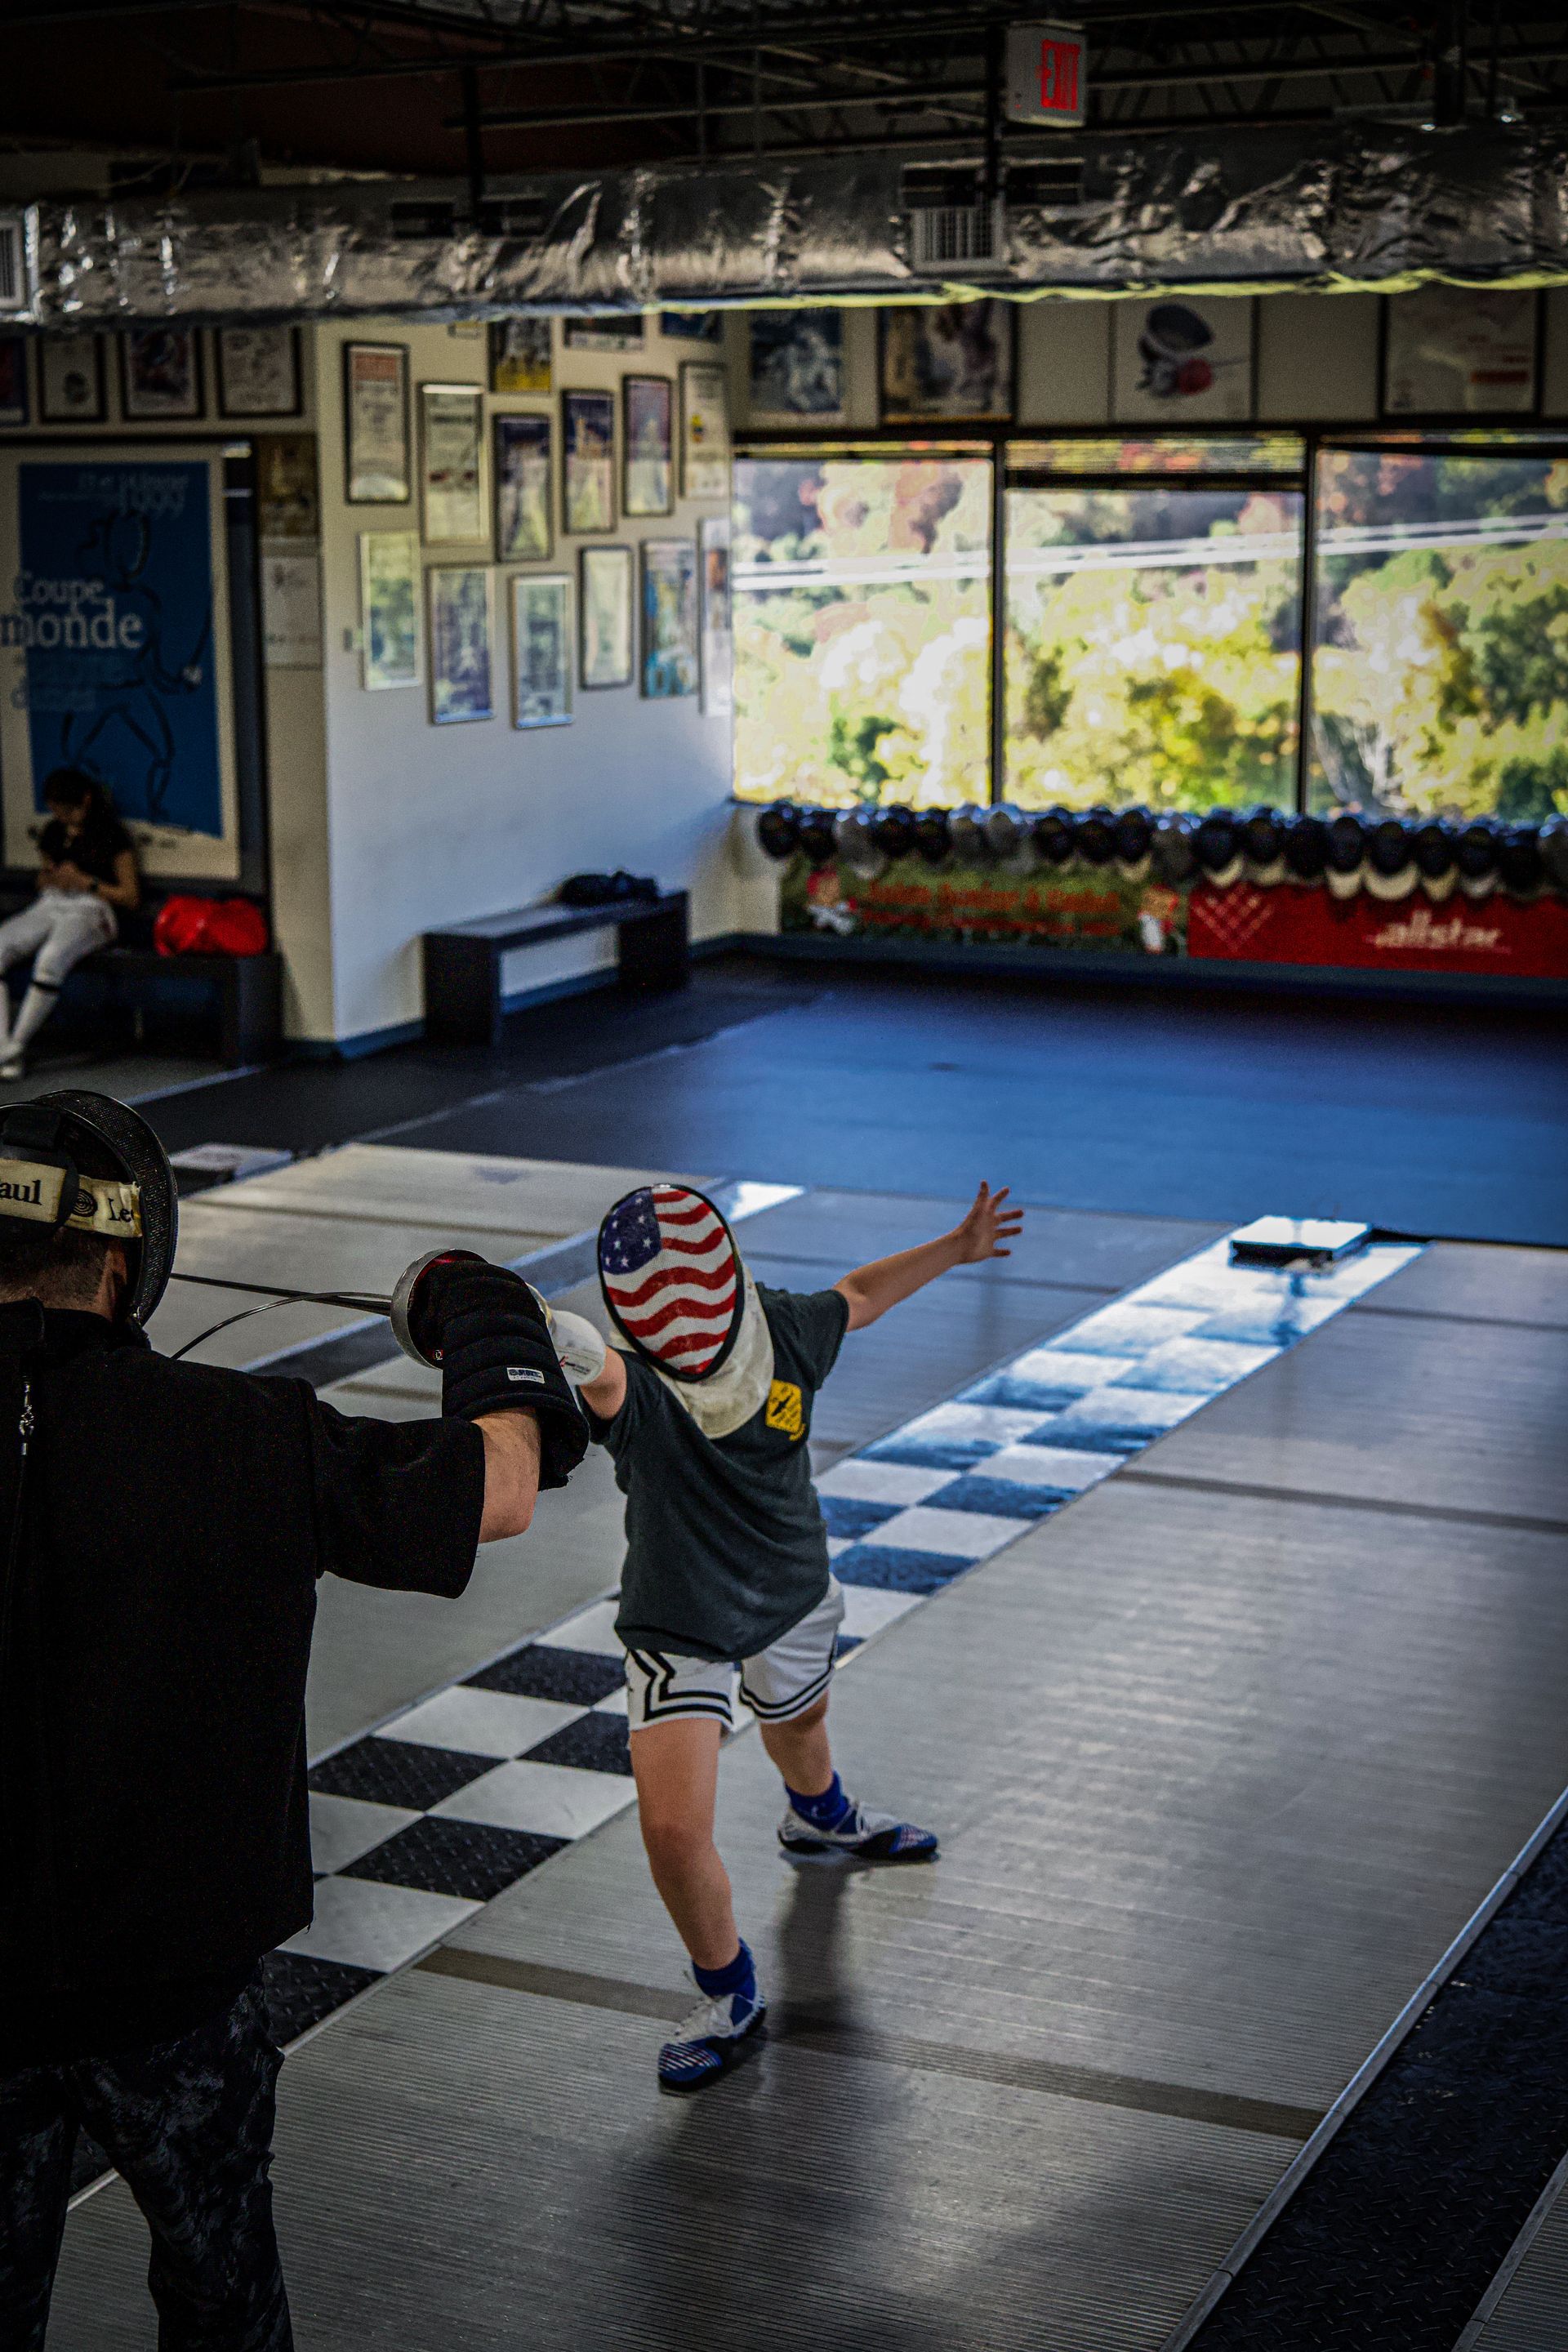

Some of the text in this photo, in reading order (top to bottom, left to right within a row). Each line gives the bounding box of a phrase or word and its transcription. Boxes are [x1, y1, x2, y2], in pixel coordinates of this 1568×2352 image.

[14, 570, 105, 613] Coupe
[0, 595, 144, 649] monde
[0, 1178, 42, 1206] aul
